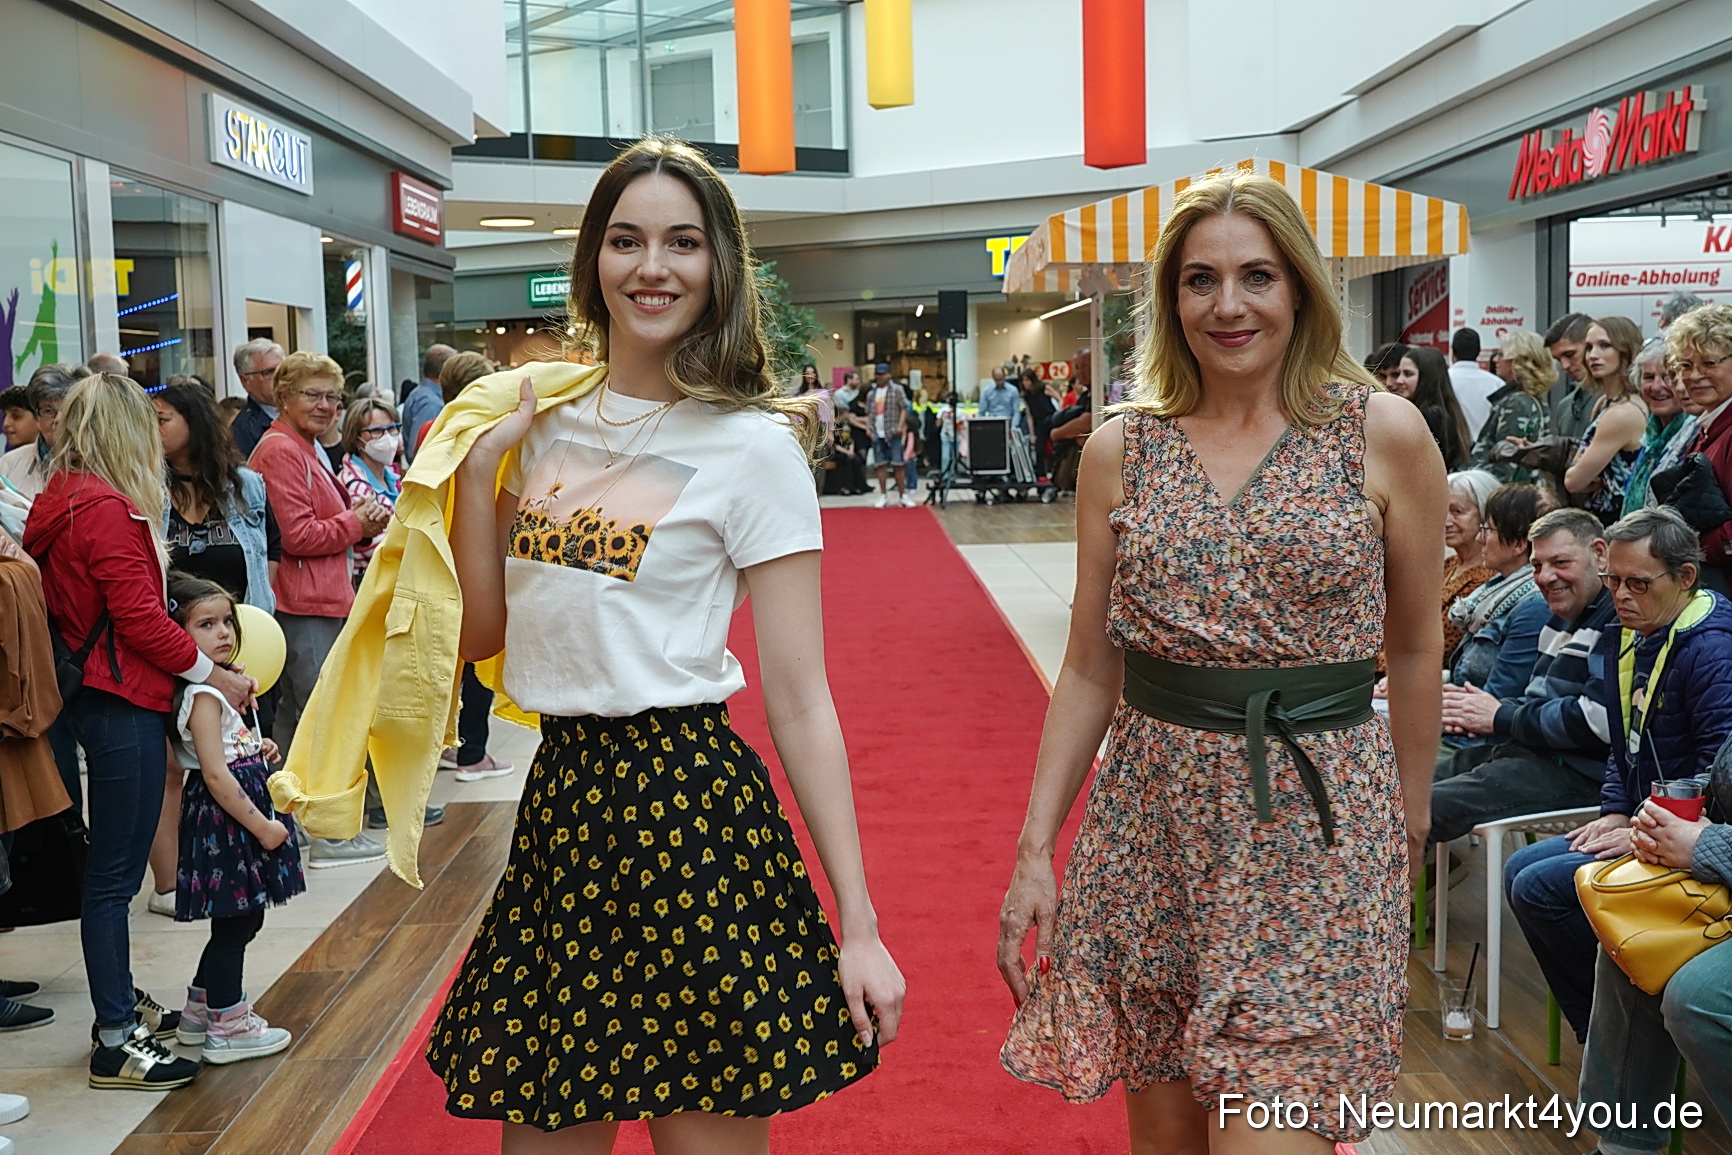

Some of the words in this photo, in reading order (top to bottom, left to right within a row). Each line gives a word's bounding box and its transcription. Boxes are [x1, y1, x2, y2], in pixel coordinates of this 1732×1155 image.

[225, 108, 308, 184] STARCUT
[1508, 129, 1585, 200] Media
[1602, 85, 1696, 174] Markt
[1575, 268, 1721, 287] Online-Abholung
[1479, 316, 1524, 327] Abholung
